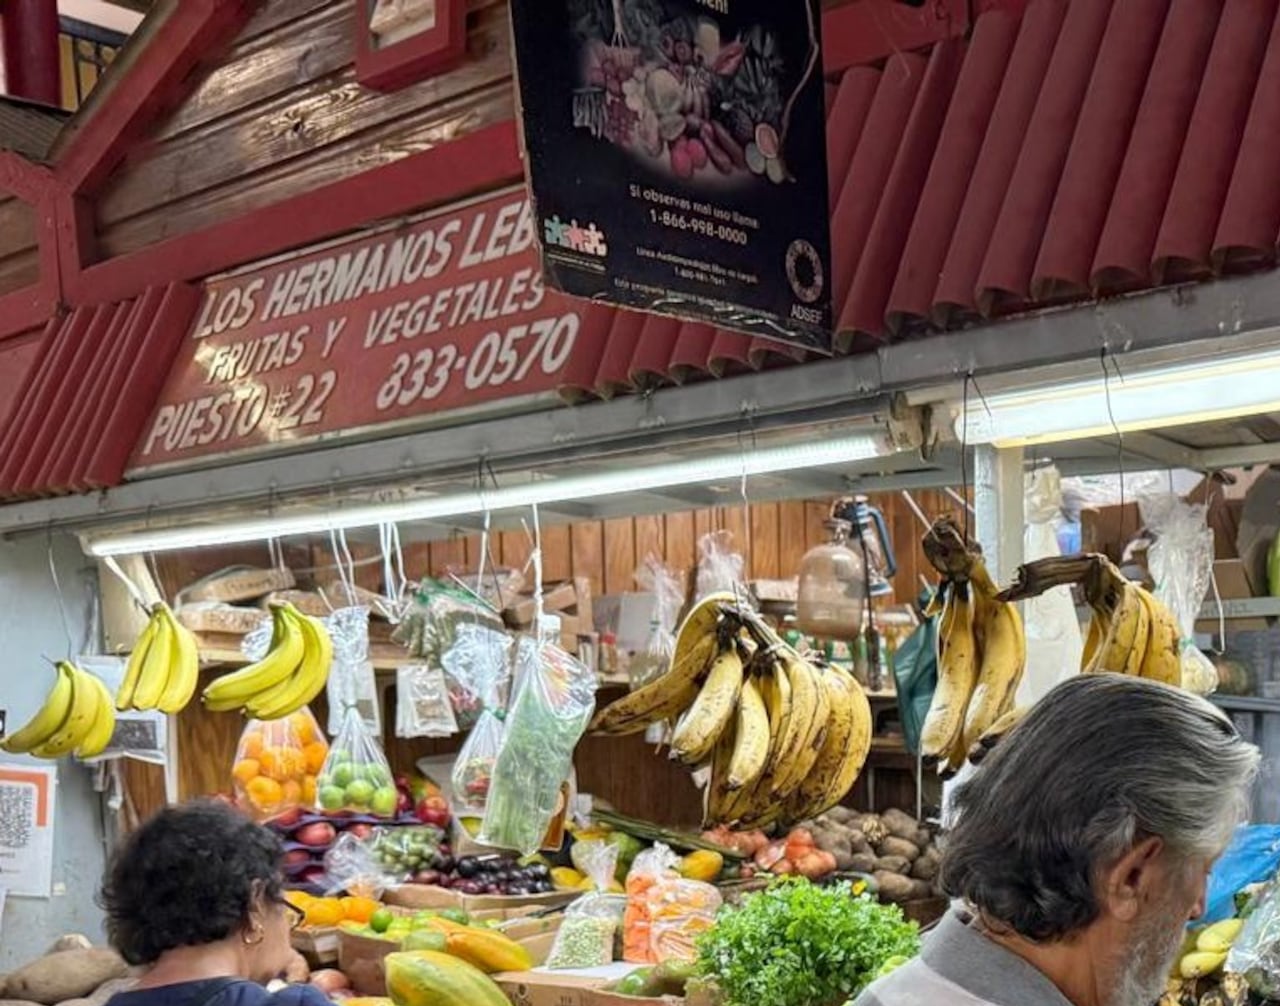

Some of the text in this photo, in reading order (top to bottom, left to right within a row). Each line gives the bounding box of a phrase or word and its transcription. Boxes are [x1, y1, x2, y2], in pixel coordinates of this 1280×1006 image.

[643, 188, 691, 211] observas
[693, 201, 712, 216] mal
[649, 208, 748, 245] 1-866-998-0000
[192, 278, 264, 340] LOS
[260, 218, 461, 322] HERMANOS
[206, 266, 545, 385] FRUTAS Y VEGETALES
[790, 303, 822, 325] ADSEF
[142, 383, 271, 456] PUESTO
[269, 369, 336, 430] #22
